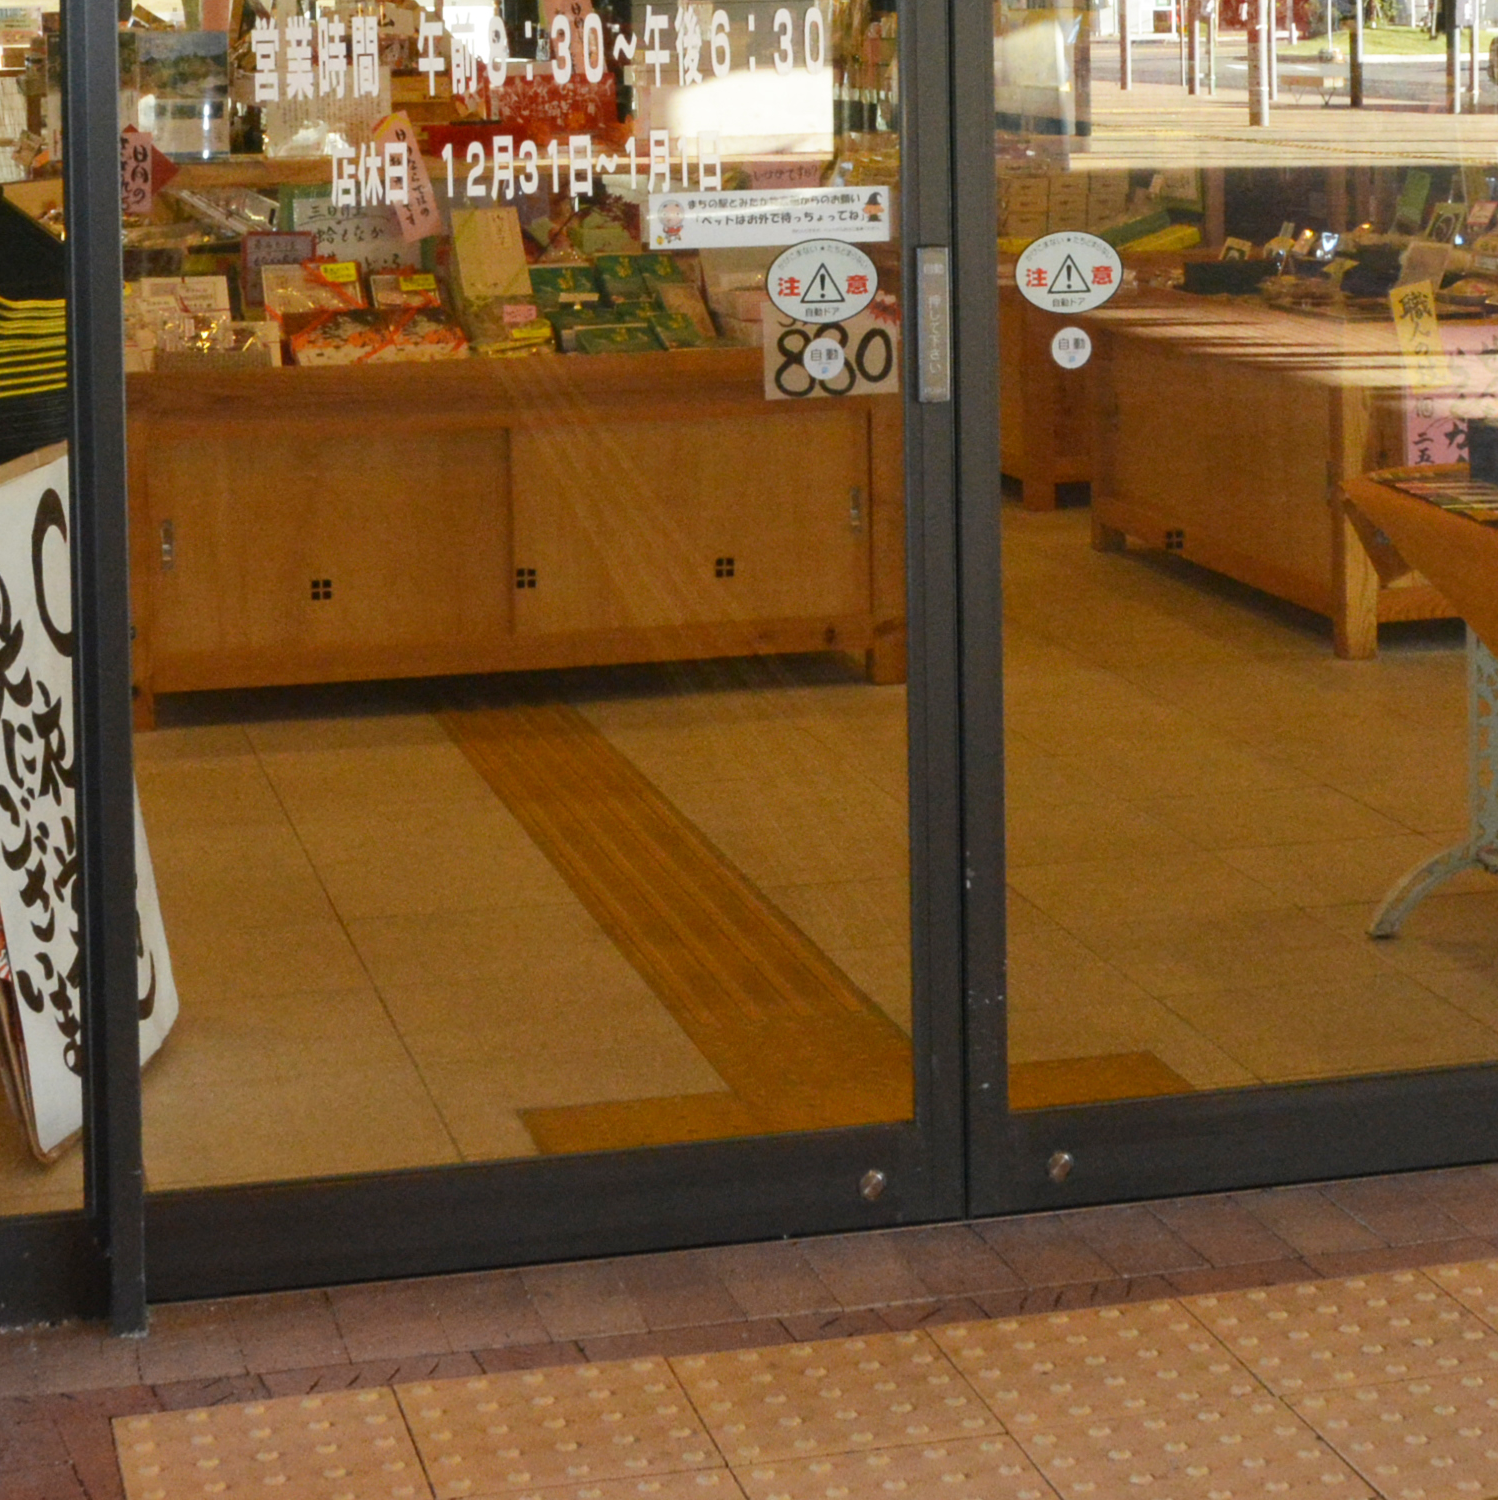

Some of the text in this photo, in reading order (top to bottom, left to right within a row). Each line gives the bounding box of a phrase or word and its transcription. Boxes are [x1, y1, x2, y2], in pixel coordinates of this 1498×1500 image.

[250, 14, 380, 102] 営業時間
[331, 141, 410, 208] 店休日
[778, 274, 869, 297] 注 意
[1026, 265, 1114, 288] 注 意
[1052, 297, 1086, 308] 自動ドア
[805, 307, 839, 317] 自動ドア
[1058, 337, 1086, 351] 自動
[810, 349, 839, 362] 自動
